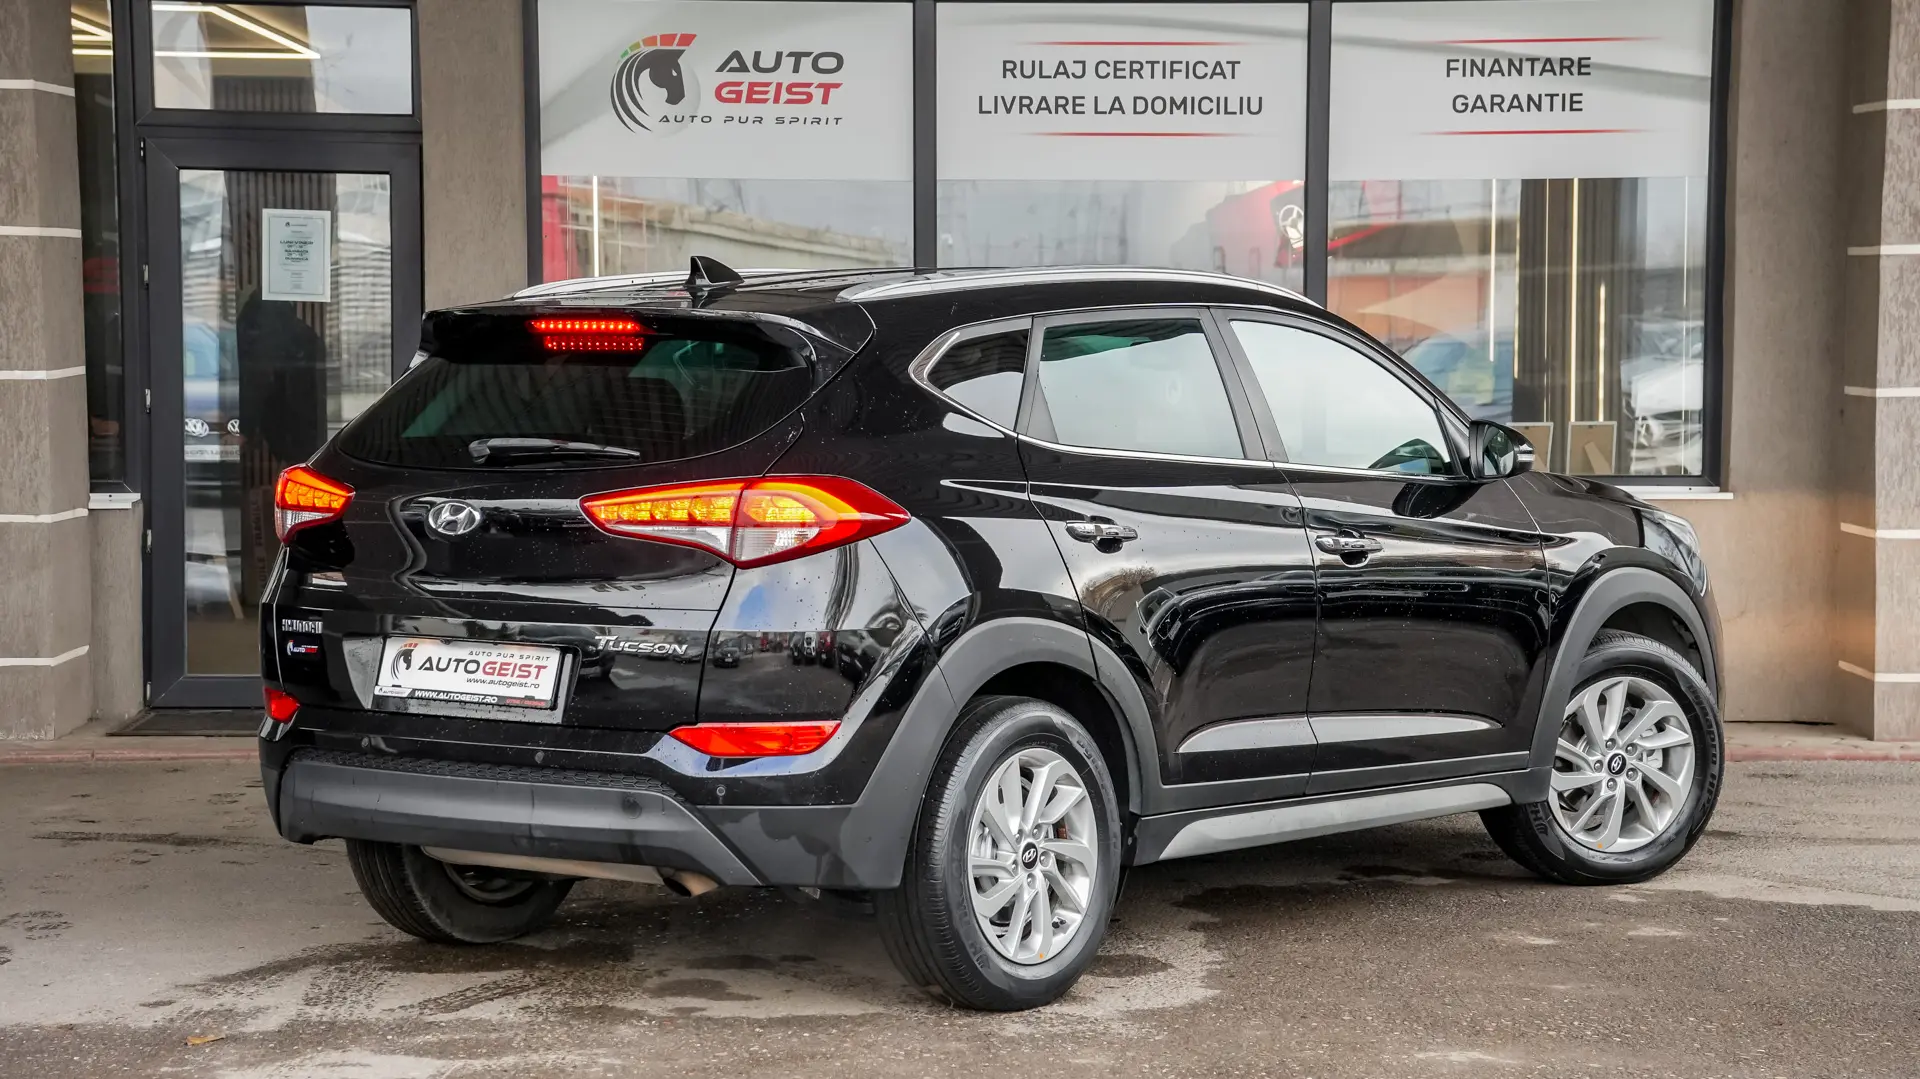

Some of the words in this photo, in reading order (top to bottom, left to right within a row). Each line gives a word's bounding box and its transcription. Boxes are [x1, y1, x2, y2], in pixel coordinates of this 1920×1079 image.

[715, 50, 845, 75] AUTO
[1002, 60, 1086, 79] RULAJ
[1094, 60, 1241, 79] CERTIFICAT
[1446, 57, 1592, 78] FINANTARE
[714, 81, 844, 105] GEIST
[978, 95, 1086, 115] LIVRARE
[1093, 96, 1126, 115] LA
[1132, 96, 1263, 115] DOMICILIU
[1452, 93, 1584, 114] GARANTIE
[658, 115, 713, 124] AUTO
[723, 115, 764, 125] PUR
[775, 116, 843, 126] SPIRIT
[468, 650, 493, 658] AUTO
[496, 652, 515, 660] PUR
[519, 654, 552, 663] SPIRIT
[466, 677, 541, 690] www.autogeist.ro
[414, 689, 499, 704] WWW.AUTOGEIST.RO
